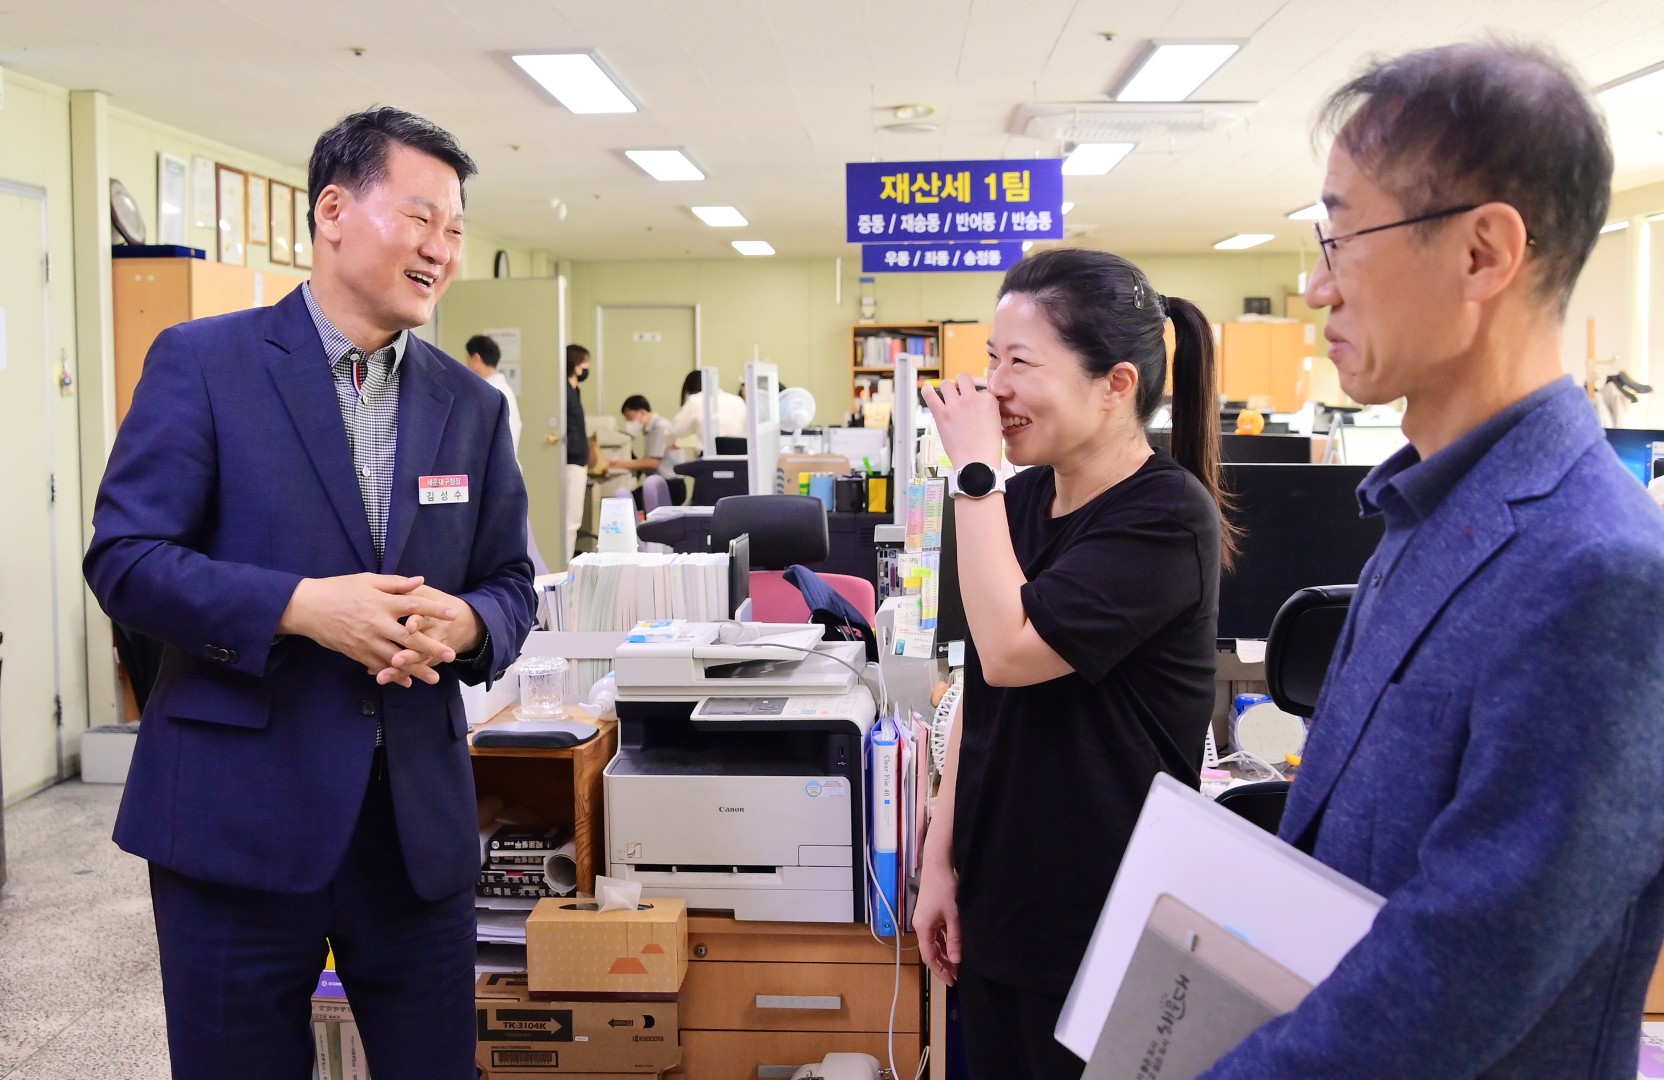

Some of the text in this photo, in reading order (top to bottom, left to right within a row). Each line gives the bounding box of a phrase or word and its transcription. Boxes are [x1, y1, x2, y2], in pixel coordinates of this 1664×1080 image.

[879, 170, 1031, 204] 재산세 1팀
[857, 214, 886, 234] 중동
[900, 213, 941, 233] 재송동
[956, 212, 996, 232] 반여동
[1011, 210, 1053, 232] 반송동
[884, 251, 910, 267] 우동
[924, 250, 950, 266] 좌동
[963, 250, 1002, 266] 송정동
[883, 789, 890, 797] 40
[502, 1021, 547, 1030] TK-3104K
